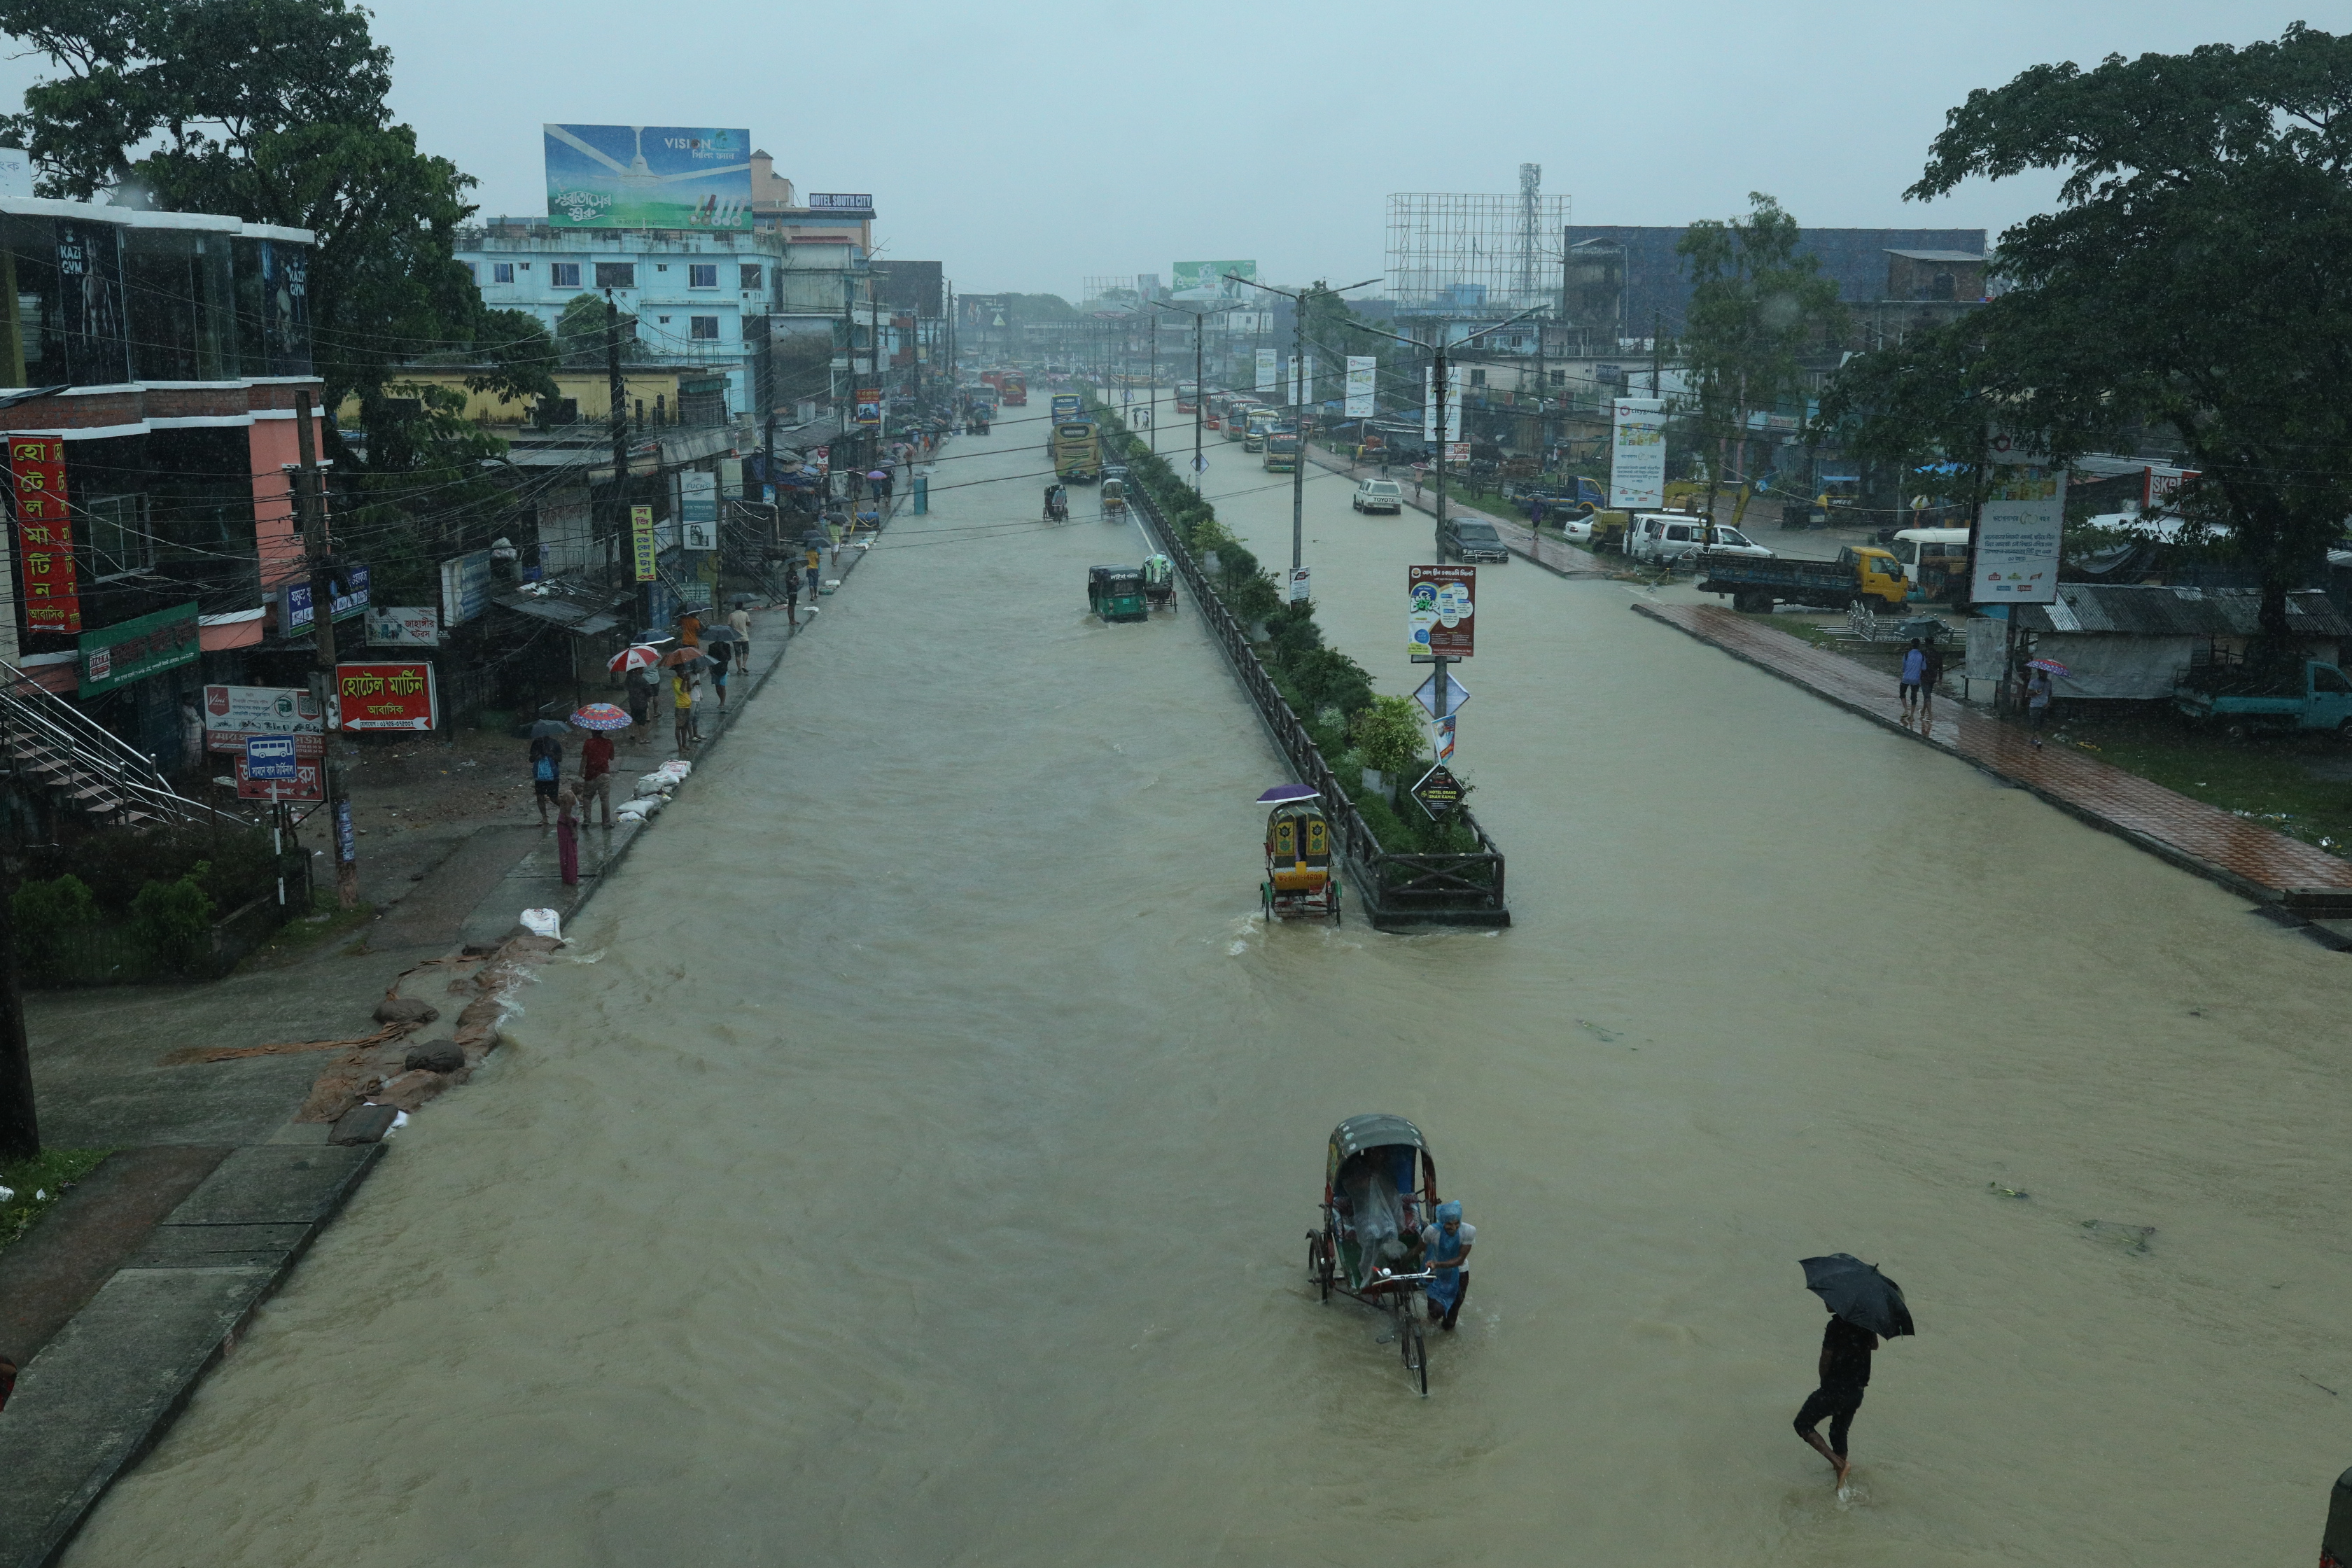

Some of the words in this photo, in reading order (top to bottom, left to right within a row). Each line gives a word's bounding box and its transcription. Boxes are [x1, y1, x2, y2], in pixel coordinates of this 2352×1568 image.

[664, 138, 710, 149] VISION
[811, 195, 832, 206] HOTEL
[832, 195, 854, 206] SOUTH
[855, 195, 872, 206] CITY
[60, 246, 81, 260] KAZI
[62, 260, 83, 275] GYM
[289, 270, 304, 283] KAZI
[290, 283, 304, 296] GYM
[404, 617, 435, 629] জাহাঙ্গীর
[342, 670, 384, 699] হোটেল
[387, 668, 424, 696] মার্টিন
[209, 694, 225, 706] Vini
[367, 702, 404, 715] আবাসিক
